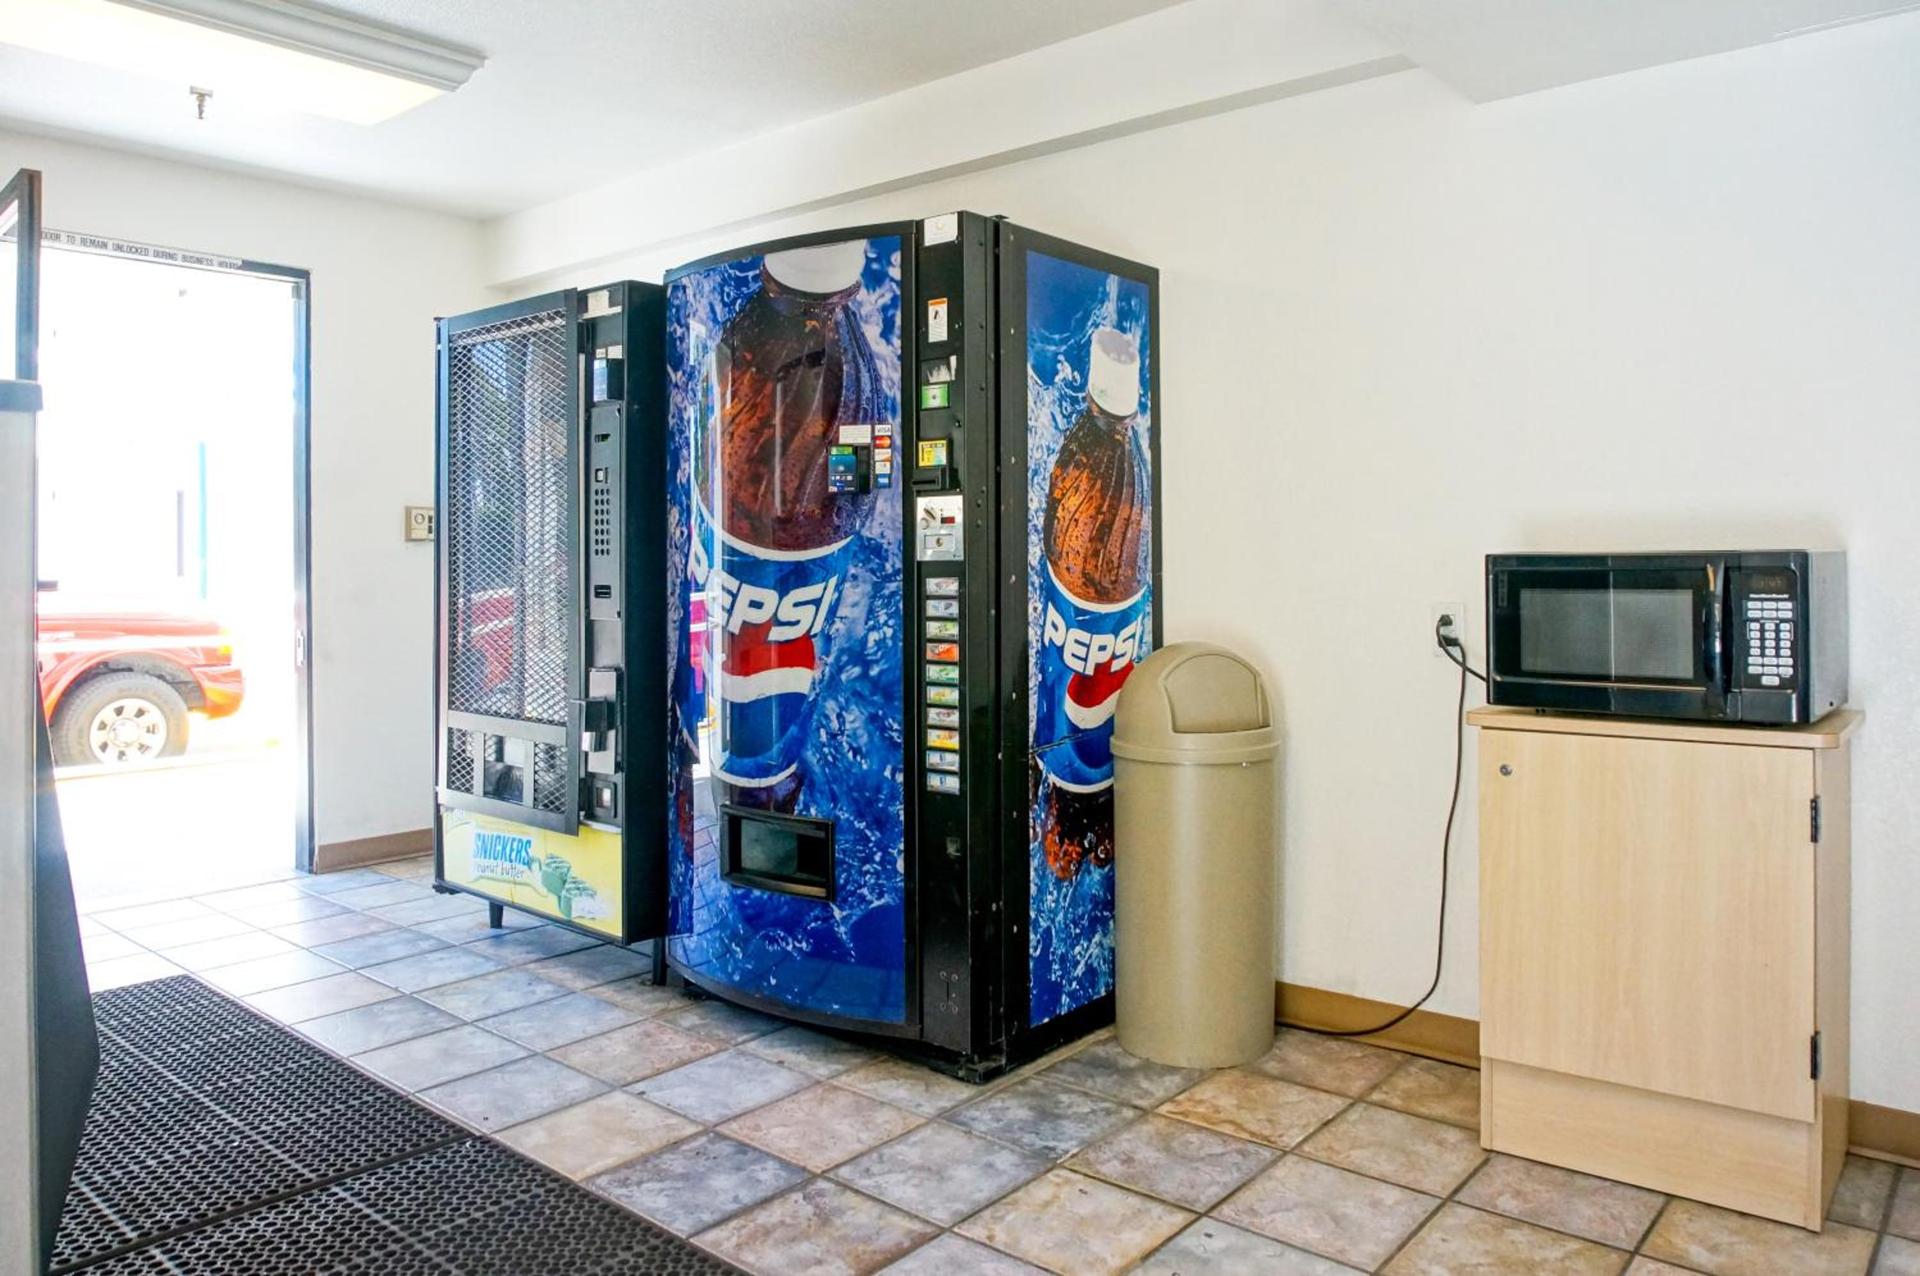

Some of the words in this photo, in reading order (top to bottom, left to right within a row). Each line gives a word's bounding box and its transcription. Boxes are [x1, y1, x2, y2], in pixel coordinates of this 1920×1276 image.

[66, 234, 76, 245] TO
[80, 236, 108, 250] REMAIN
[112, 242, 149, 257] UNLOCKED
[153, 248, 178, 262] DURING
[181, 254, 216, 267] BUSINESS
[687, 535, 839, 642] PEPSI
[1043, 600, 1143, 676] PEPSI
[472, 832, 533, 868] SNICKERS
